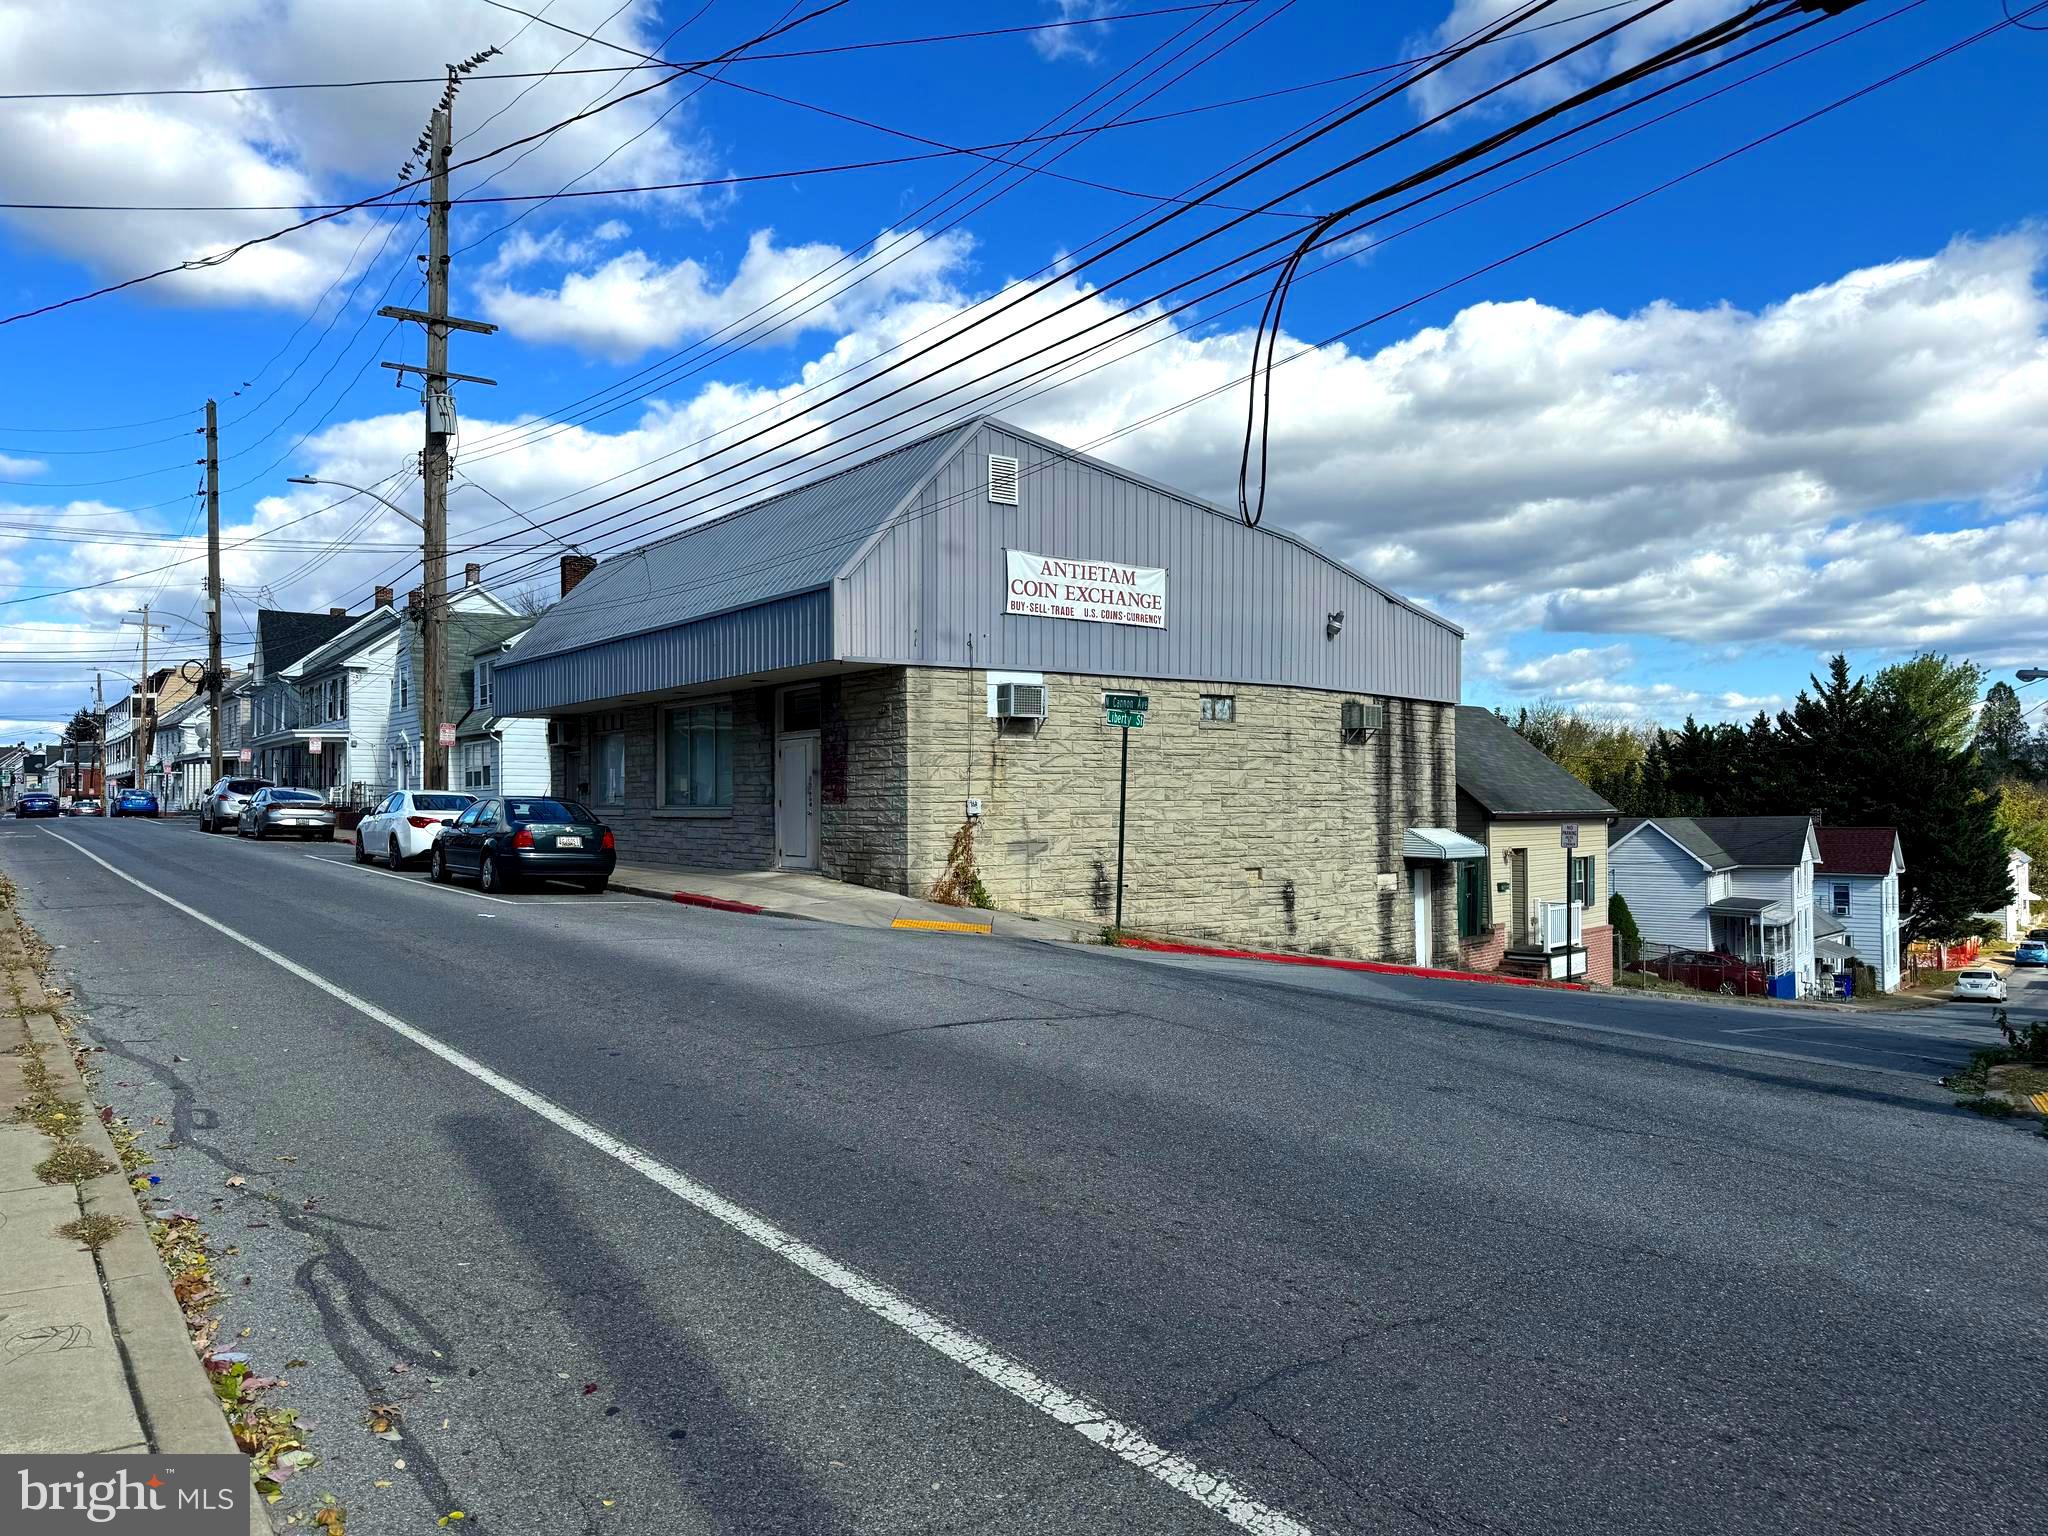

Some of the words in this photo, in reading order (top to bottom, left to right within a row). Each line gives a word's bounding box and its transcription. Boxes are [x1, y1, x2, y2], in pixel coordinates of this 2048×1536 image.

[1040, 560, 1137, 586] ANTIETAM
[1011, 578, 1059, 599] COIN
[1065, 585, 1162, 610] EXCHANGE
[1107, 711, 1131, 726] Liberty
[1136, 714, 1143, 726] St
